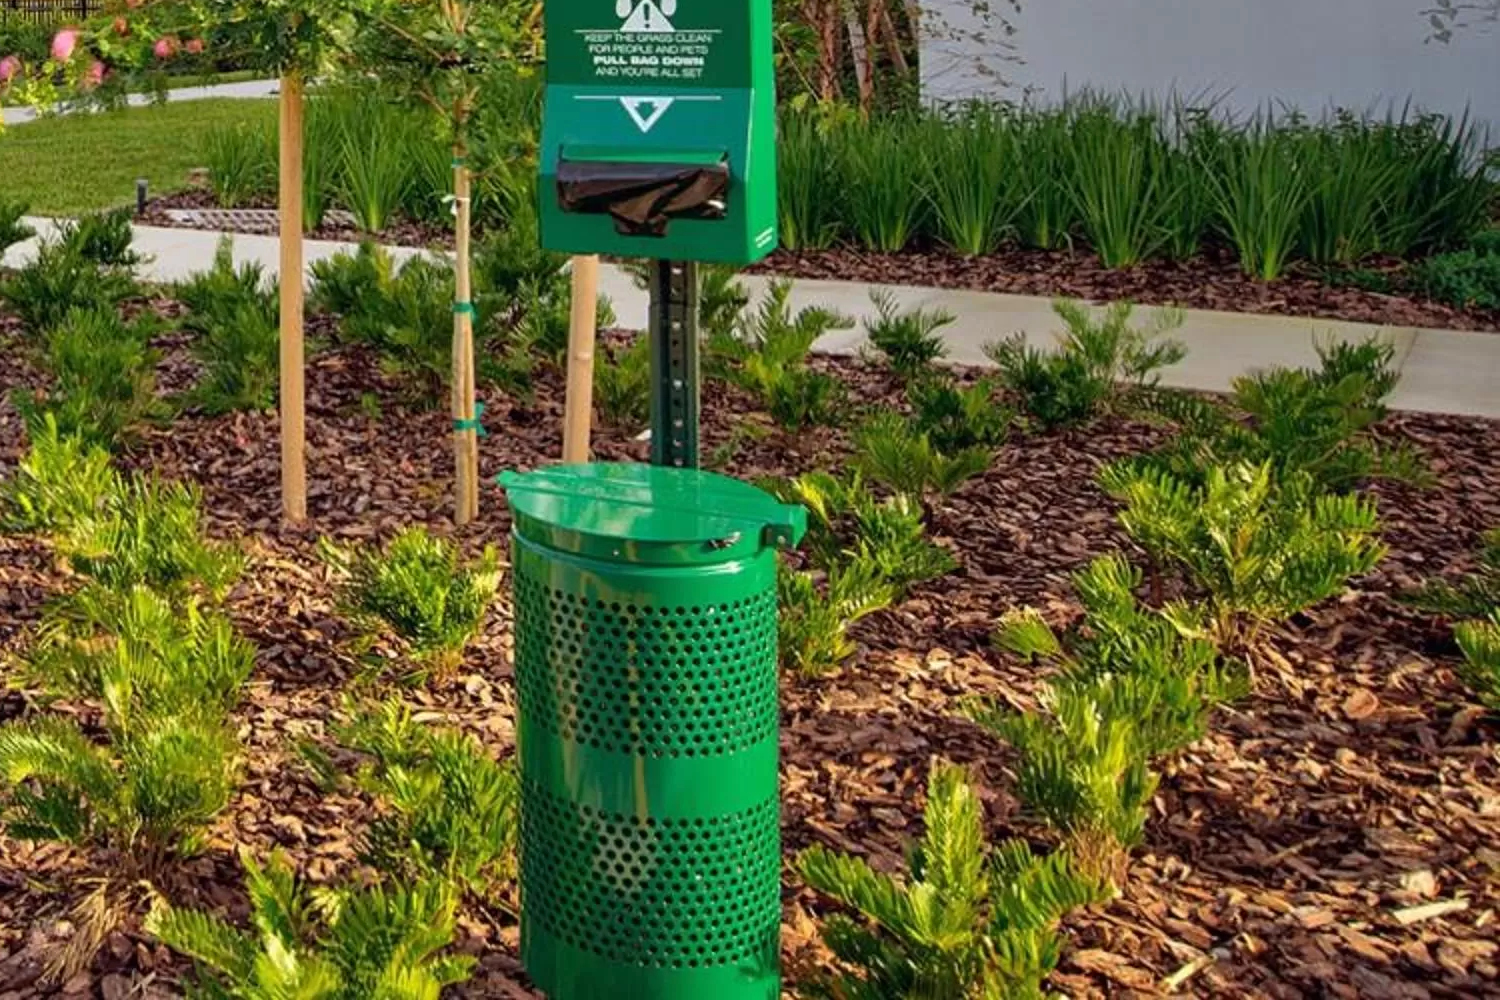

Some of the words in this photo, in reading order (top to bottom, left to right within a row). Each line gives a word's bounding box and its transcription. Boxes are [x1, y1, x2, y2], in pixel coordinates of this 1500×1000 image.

[615, 33, 635, 42] THE
[589, 44, 610, 54] FOR
[612, 44, 654, 54] PEOPLE
[655, 44, 679, 54] AND
[593, 55, 628, 65] PULL
[630, 55, 659, 65] BAG
[661, 56, 705, 66] DOWN
